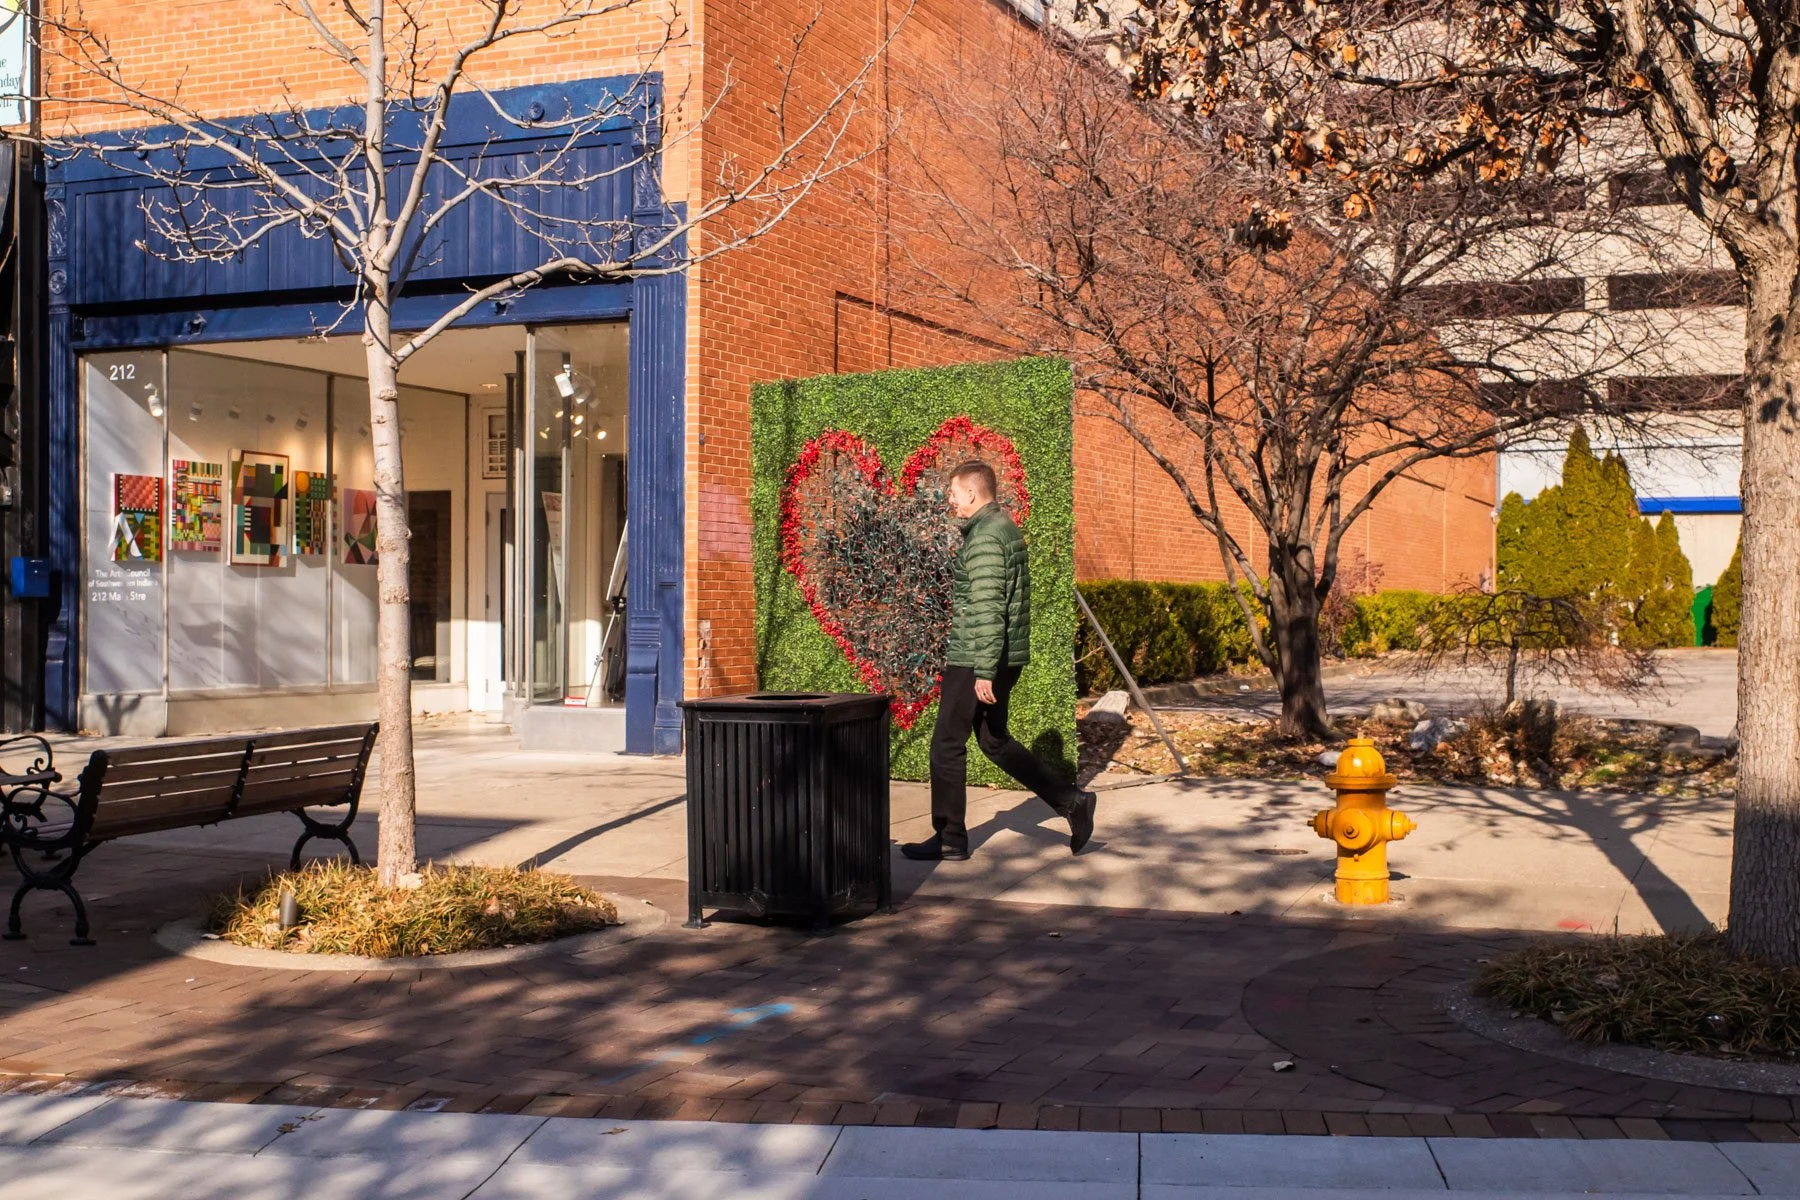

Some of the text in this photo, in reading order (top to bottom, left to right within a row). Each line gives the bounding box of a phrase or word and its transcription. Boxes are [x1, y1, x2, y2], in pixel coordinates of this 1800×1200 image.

[109, 364, 135, 380] 212
[95, 569, 107, 578] The
[110, 569, 122, 577] Art
[92, 591, 107, 602] 212
[108, 591, 129, 602] Ma
